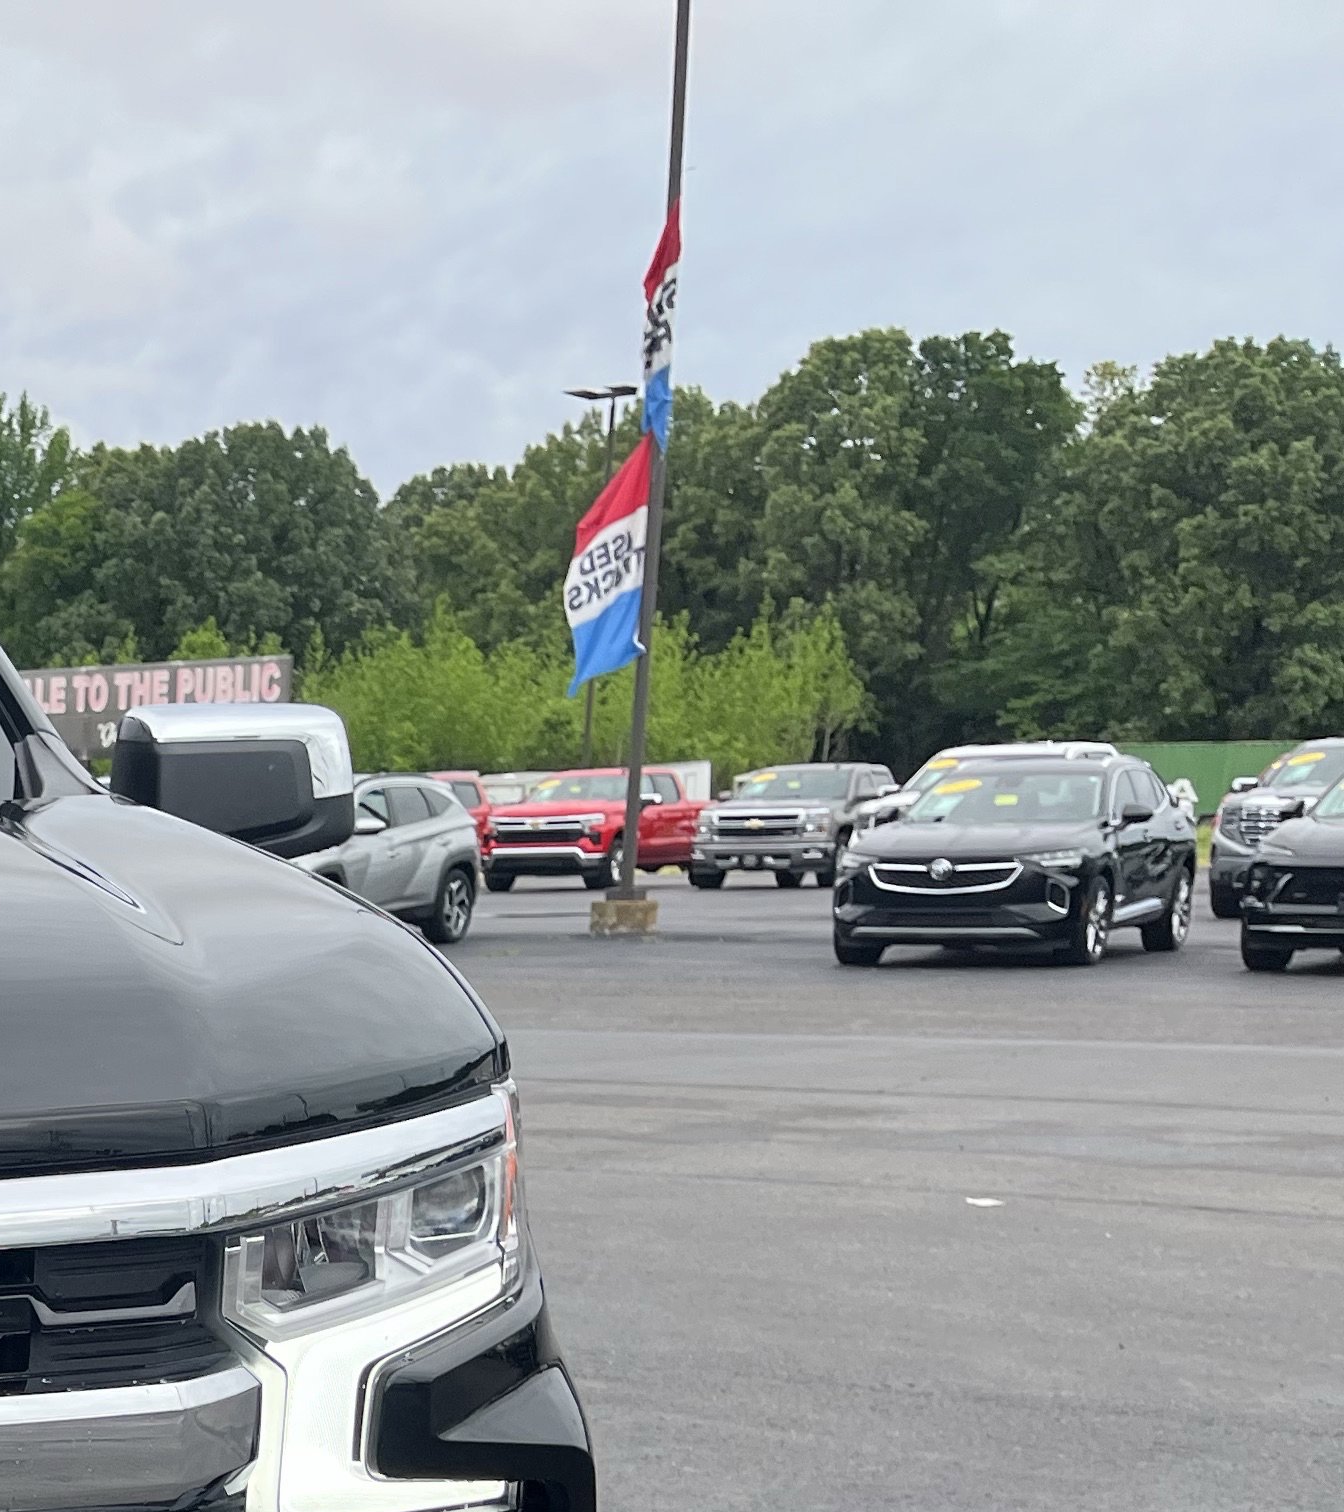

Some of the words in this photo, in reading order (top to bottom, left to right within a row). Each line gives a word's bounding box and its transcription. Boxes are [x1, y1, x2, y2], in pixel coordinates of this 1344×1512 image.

[72, 673, 109, 712] TO
[115, 669, 170, 710] THE
[176, 662, 281, 703] PUBLIC
